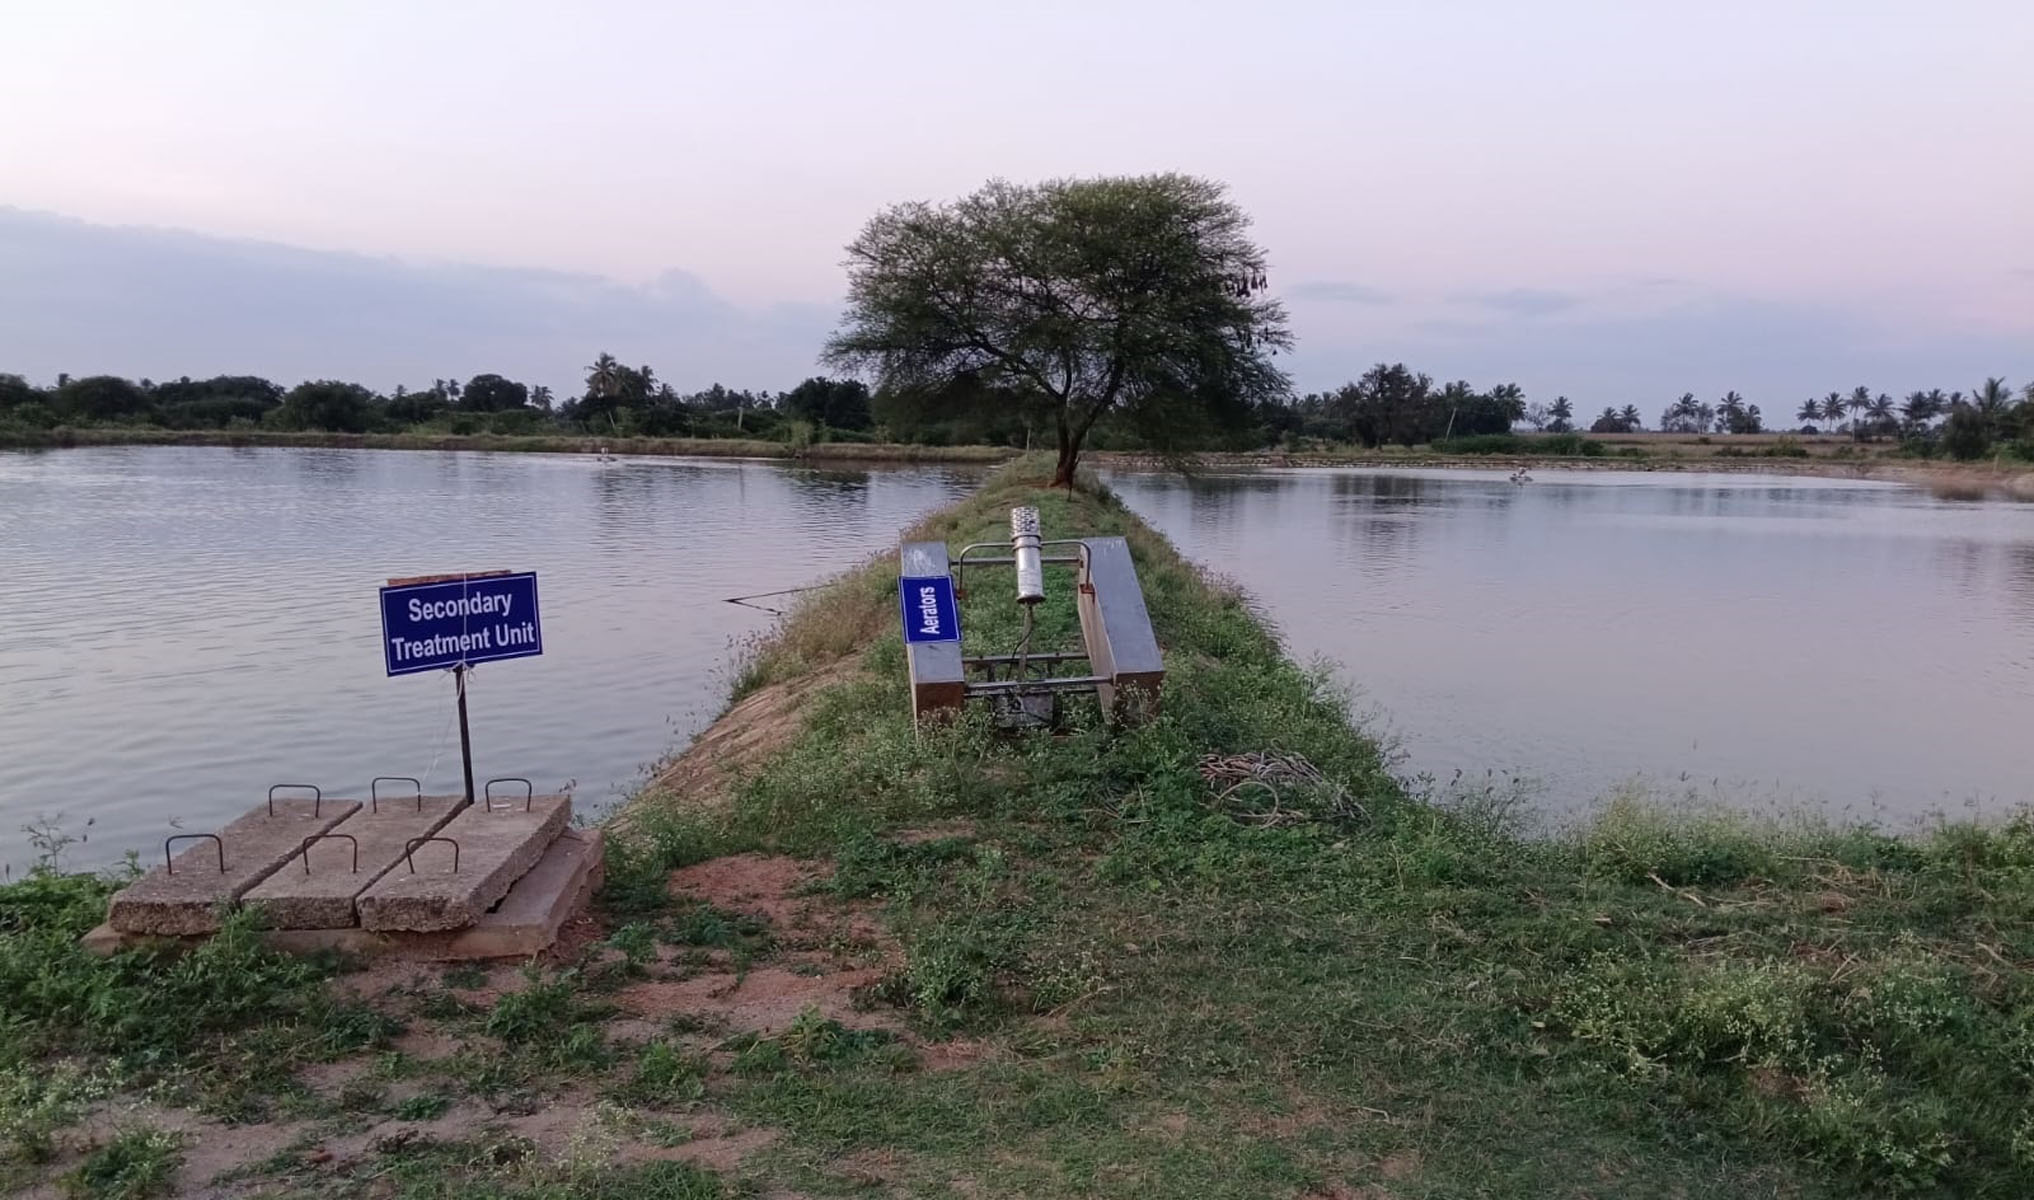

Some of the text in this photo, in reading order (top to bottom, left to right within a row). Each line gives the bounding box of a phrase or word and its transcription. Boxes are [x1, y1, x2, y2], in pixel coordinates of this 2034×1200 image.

[408, 591, 512, 622] Secondary
[919, 586, 940, 635] Aerators
[391, 621, 535, 661] Treatment Unit
